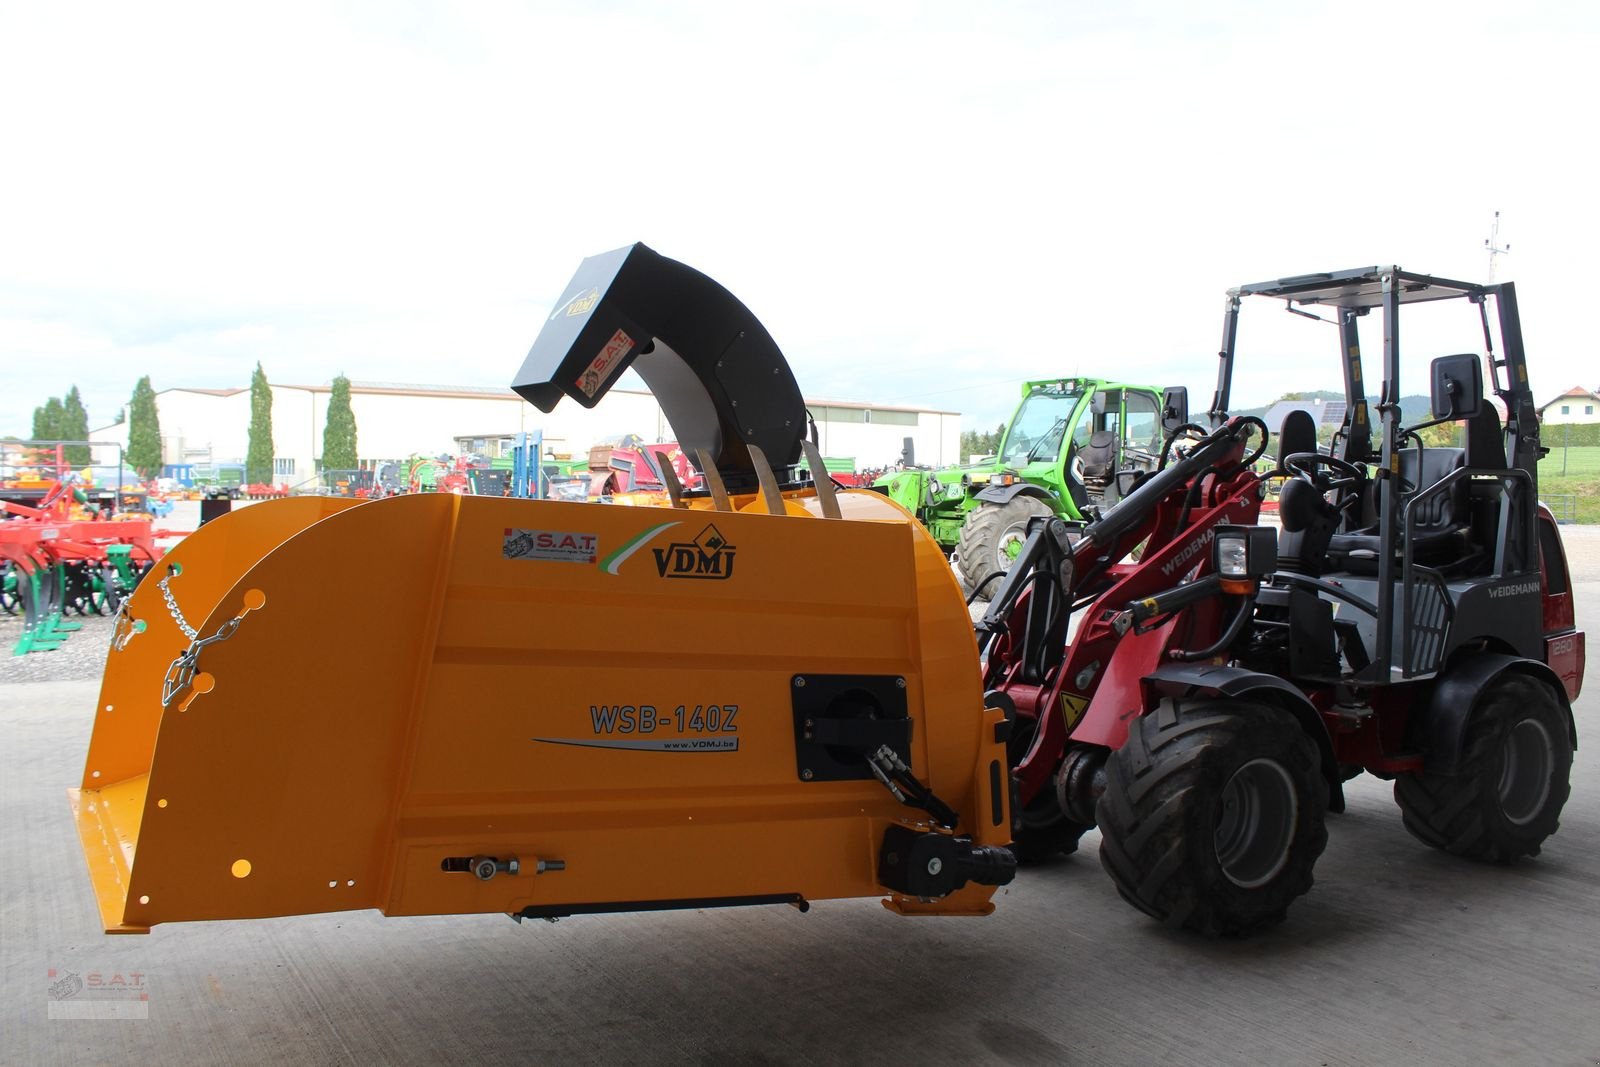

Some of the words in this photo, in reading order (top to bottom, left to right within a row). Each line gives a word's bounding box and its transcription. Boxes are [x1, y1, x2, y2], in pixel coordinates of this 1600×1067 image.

[536, 532, 596, 550] S.A.T.
[1161, 514, 1230, 576] WEIDEMAN
[652, 545, 736, 579] VDMJ
[1488, 582, 1540, 599] WEIDEMANN
[590, 705, 738, 734] WSB-140Z
[664, 741, 734, 749] www.VDMJ.be
